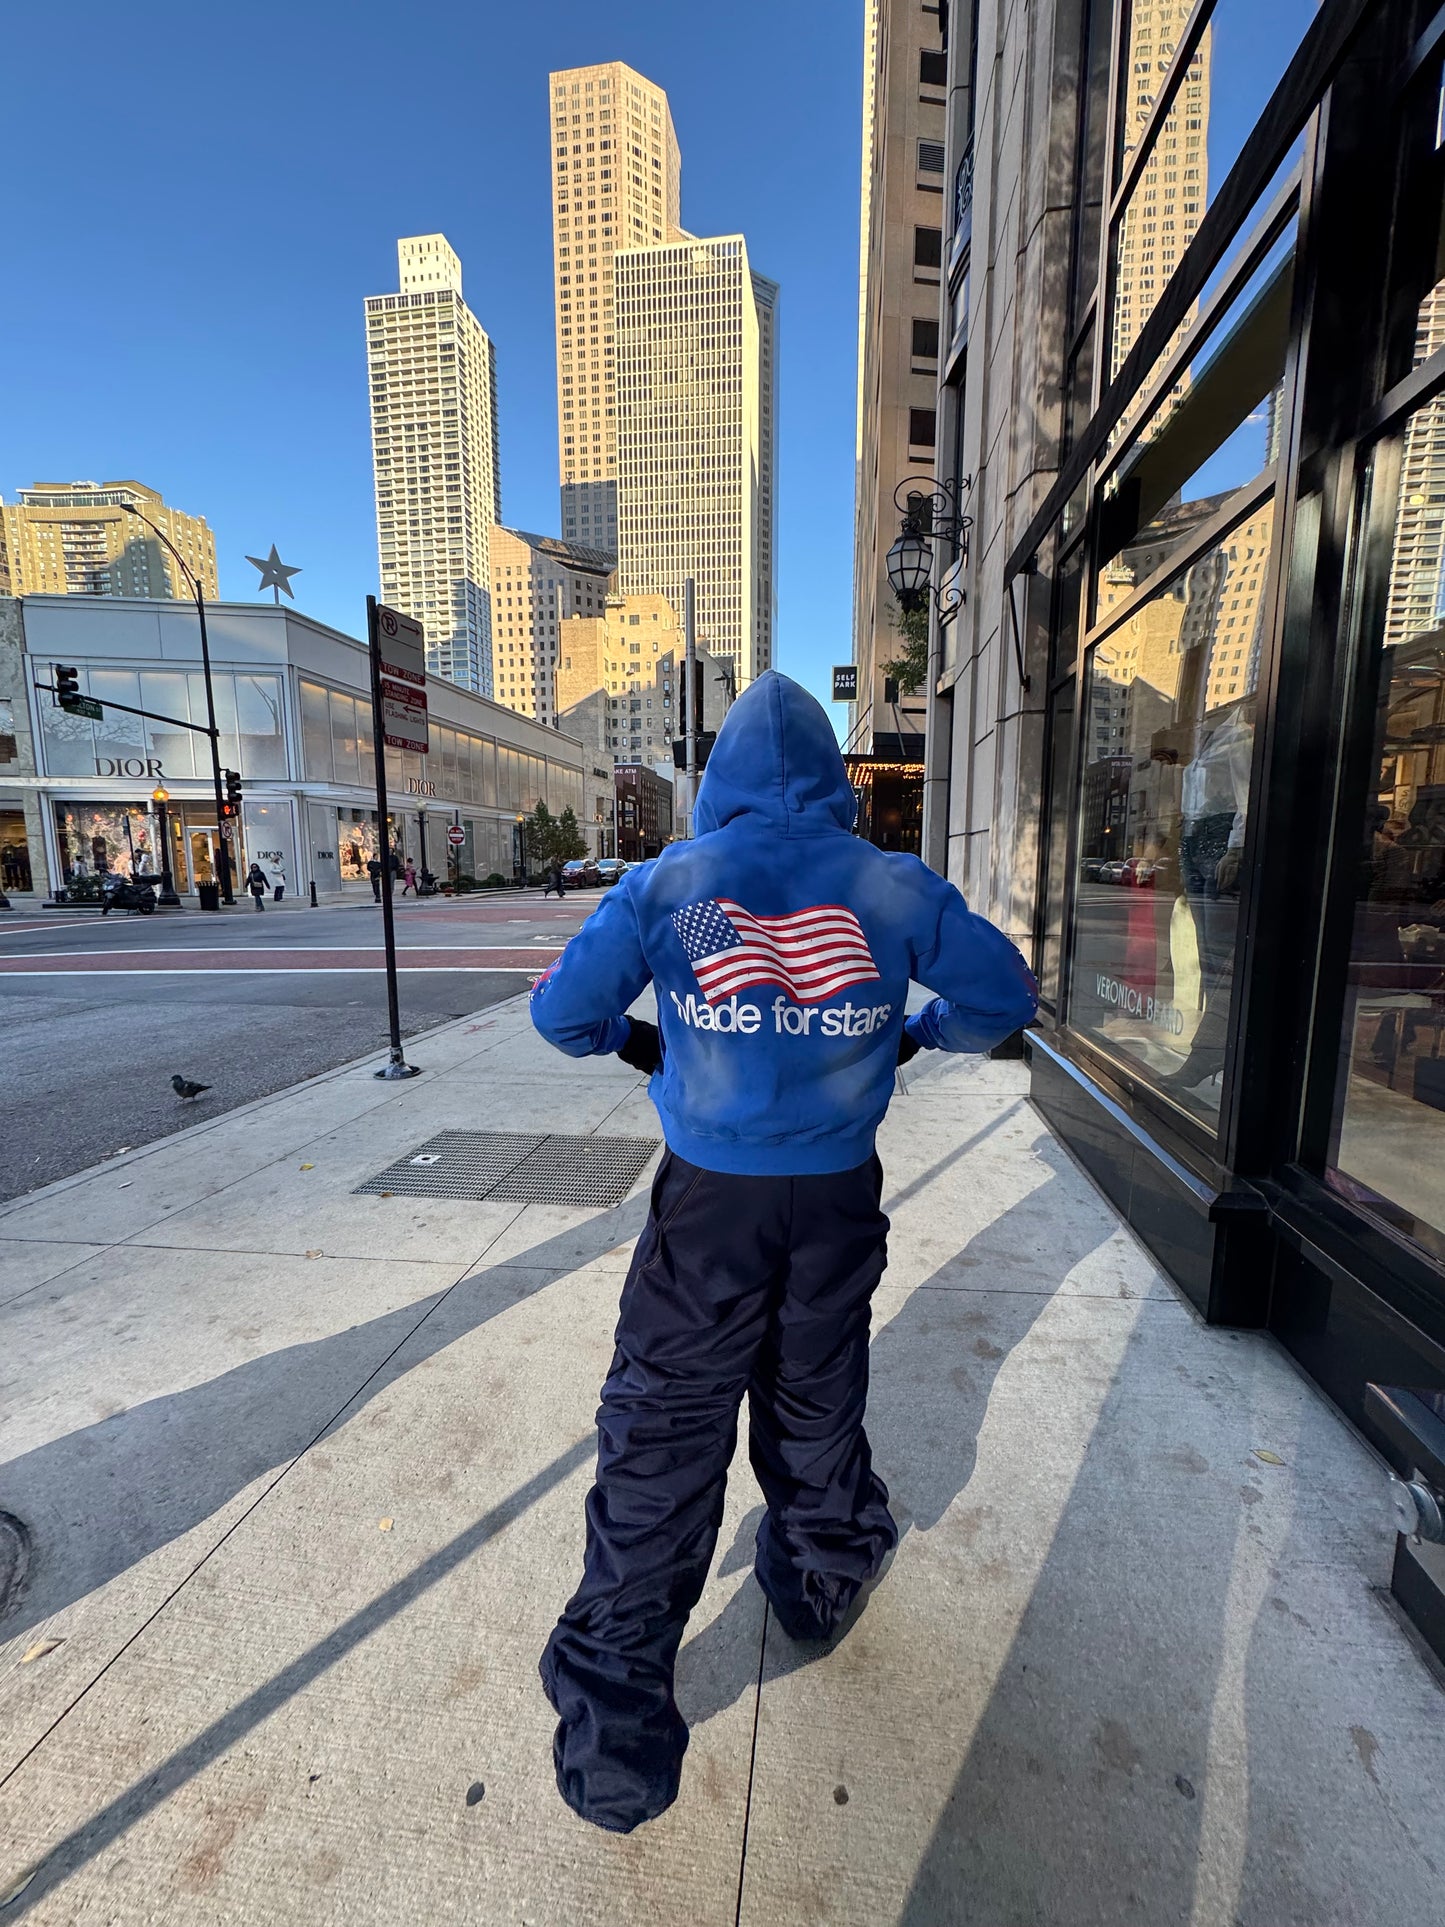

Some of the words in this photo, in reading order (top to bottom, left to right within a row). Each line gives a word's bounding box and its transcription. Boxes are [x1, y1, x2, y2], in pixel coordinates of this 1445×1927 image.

[383, 663, 399, 676] TOW
[402, 670, 422, 684] ZONE
[387, 736, 403, 746] TOW
[406, 740, 425, 752] ZONE
[92, 757, 167, 779] DIOR
[408, 777, 436, 797] DIOR
[257, 851, 284, 860] DIOR
[317, 851, 334, 859] DIOR
[1096, 973, 1142, 1017] VERONICA
[670, 990, 762, 1033] Made
[771, 995, 819, 1035] for
[820, 1002, 892, 1037] stars
